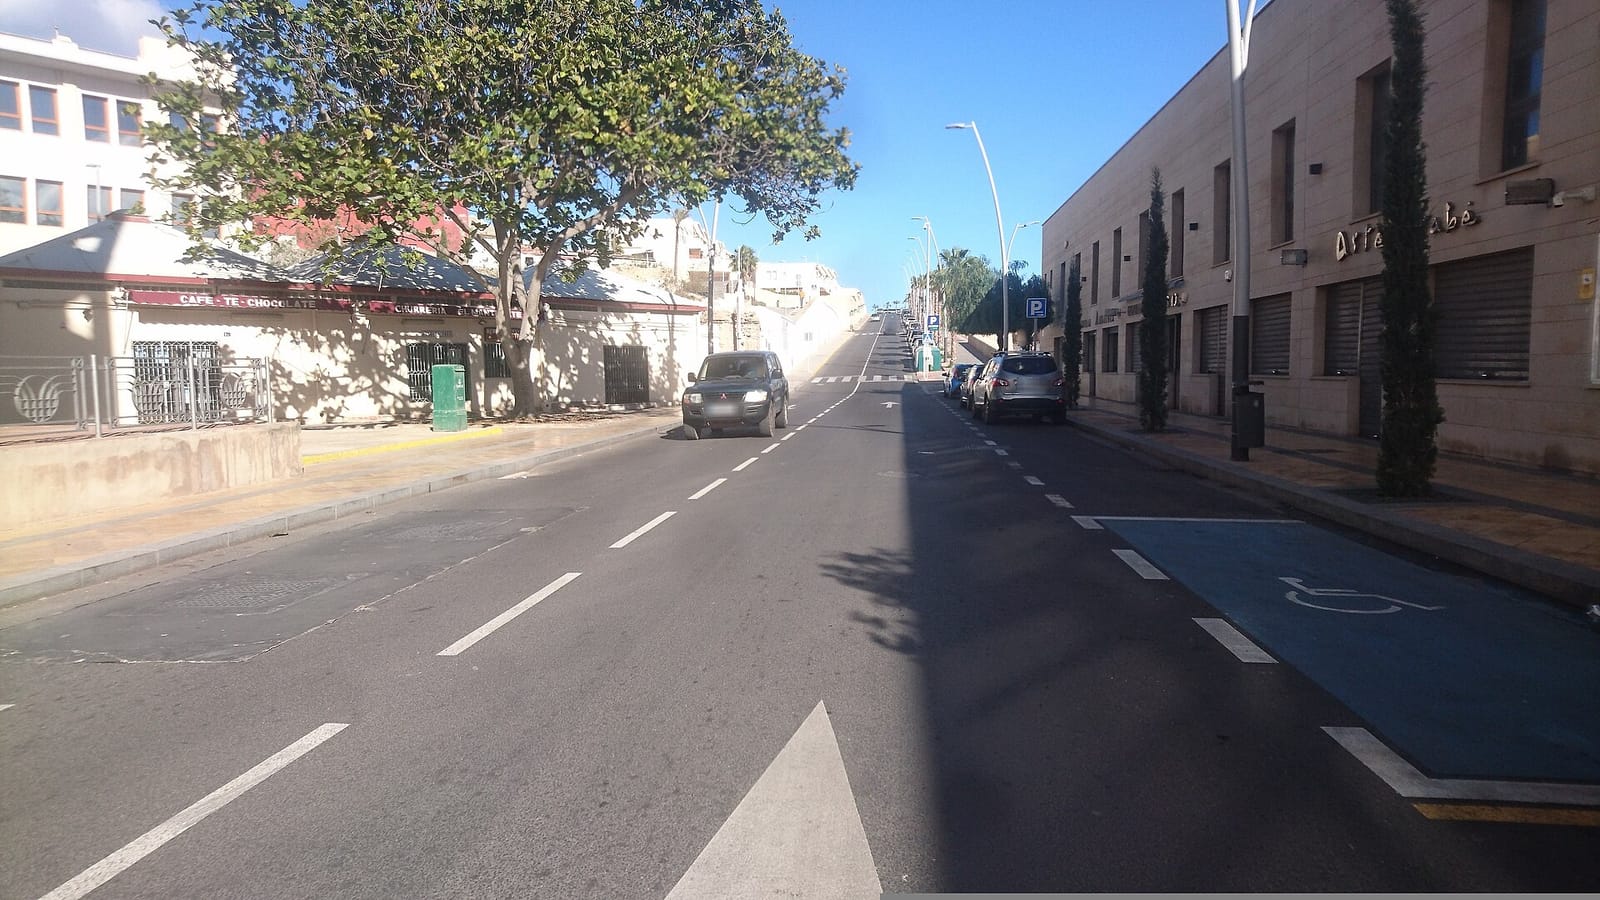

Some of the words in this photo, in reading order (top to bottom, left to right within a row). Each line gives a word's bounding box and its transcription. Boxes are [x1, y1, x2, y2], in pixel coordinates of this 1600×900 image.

[180, 294, 213, 305] CAFE
[223, 297, 239, 306] TE
[246, 298, 316, 308] CHOCOLATE
[1030, 300, 1043, 315] P
[394, 304, 447, 315] CHURRERIA
